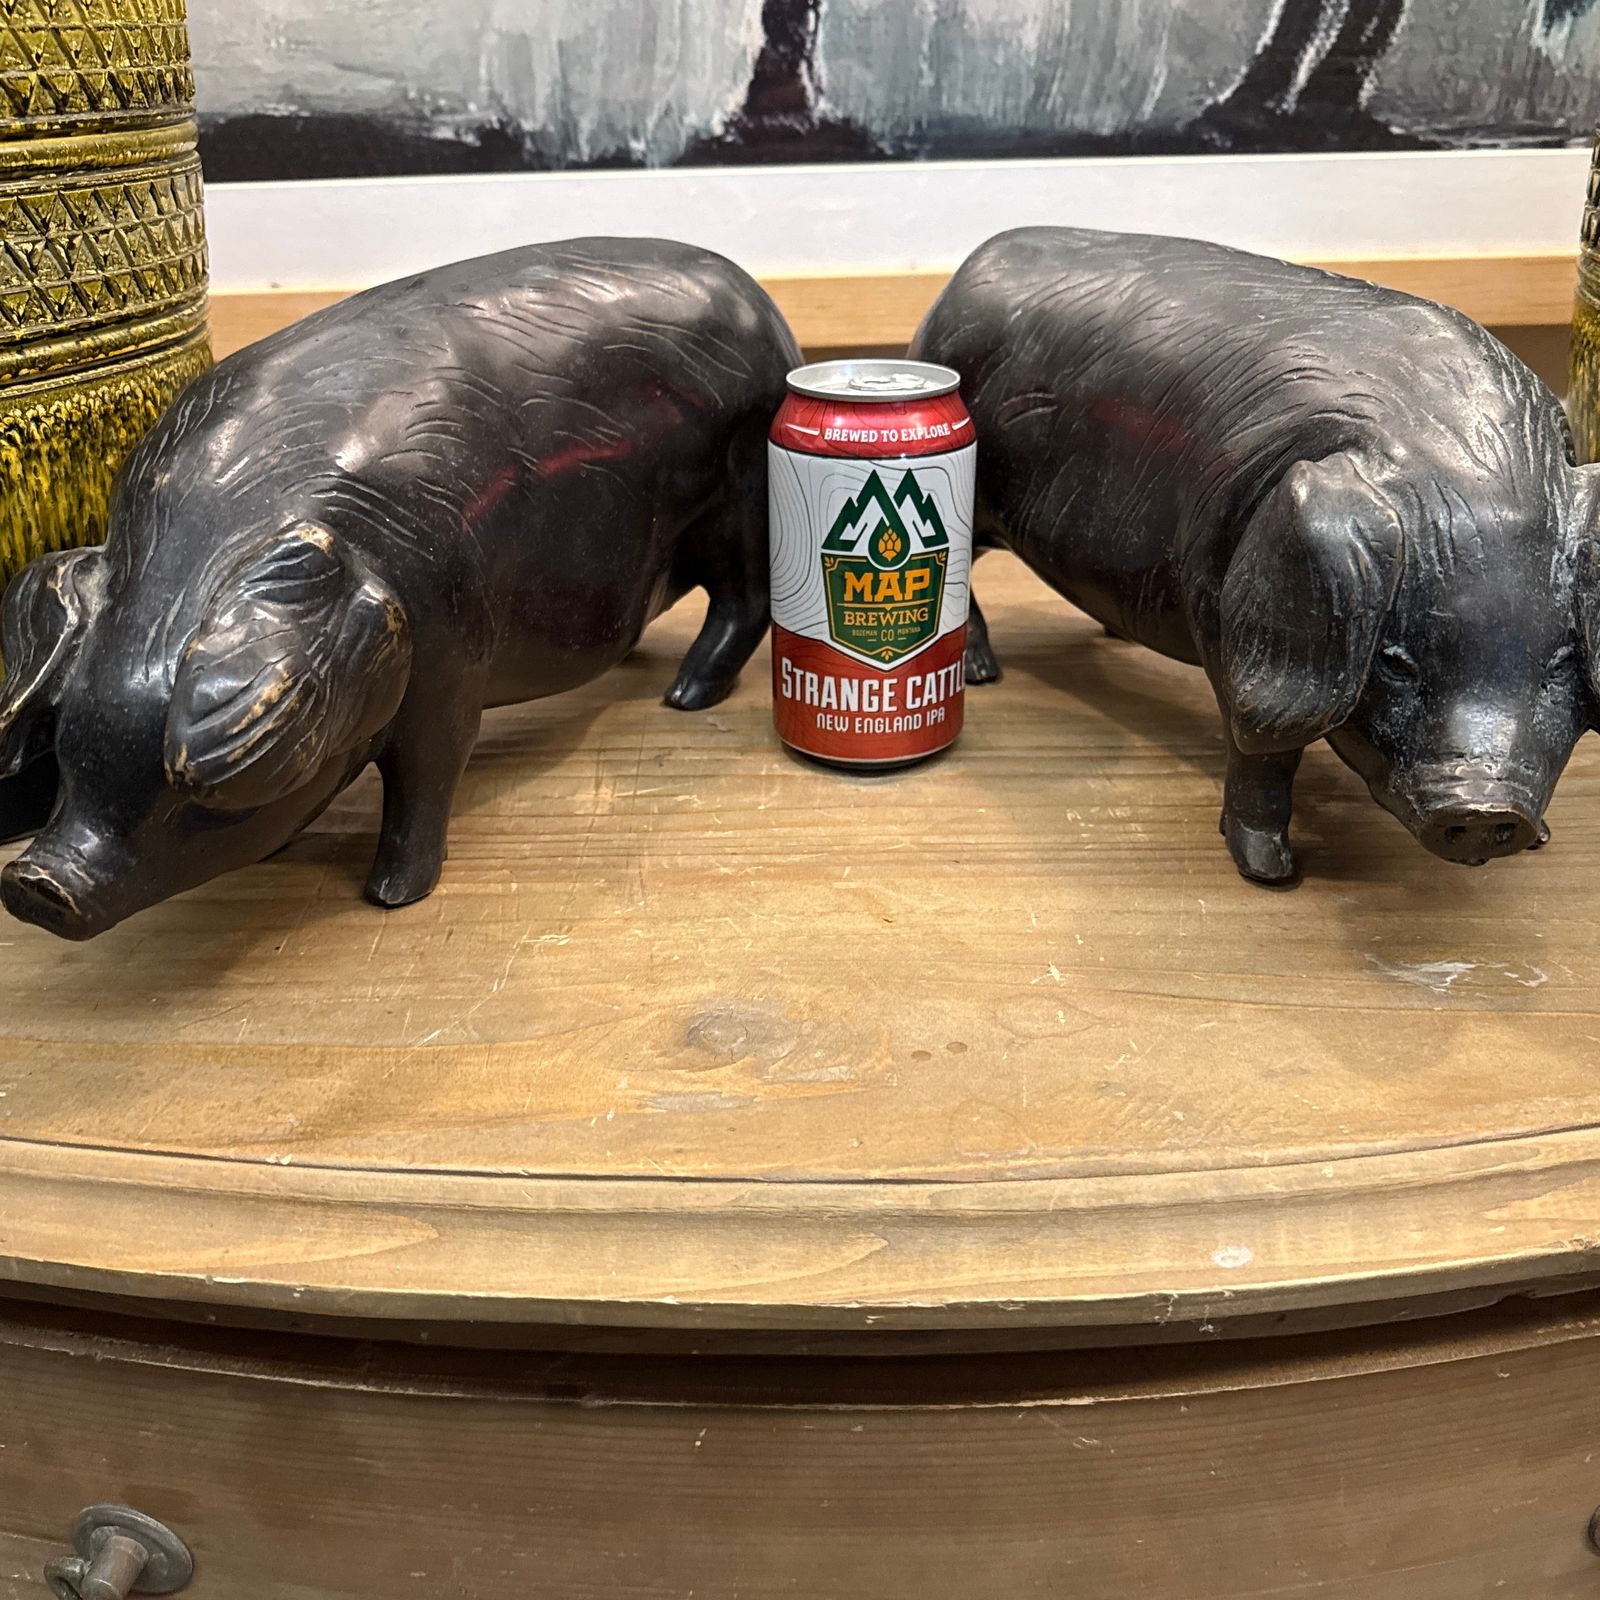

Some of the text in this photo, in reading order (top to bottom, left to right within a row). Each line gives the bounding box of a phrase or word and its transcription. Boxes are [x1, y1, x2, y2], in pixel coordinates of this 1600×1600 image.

[824, 422, 951, 442] BREWED TO EXPLORE
[843, 567, 931, 602] MAP
[843, 607, 929, 626] BREWING
[880, 629, 894, 641] CO
[781, 656, 899, 713] STRANGE
[816, 706, 946, 734] NEW ENGLAND IPA
